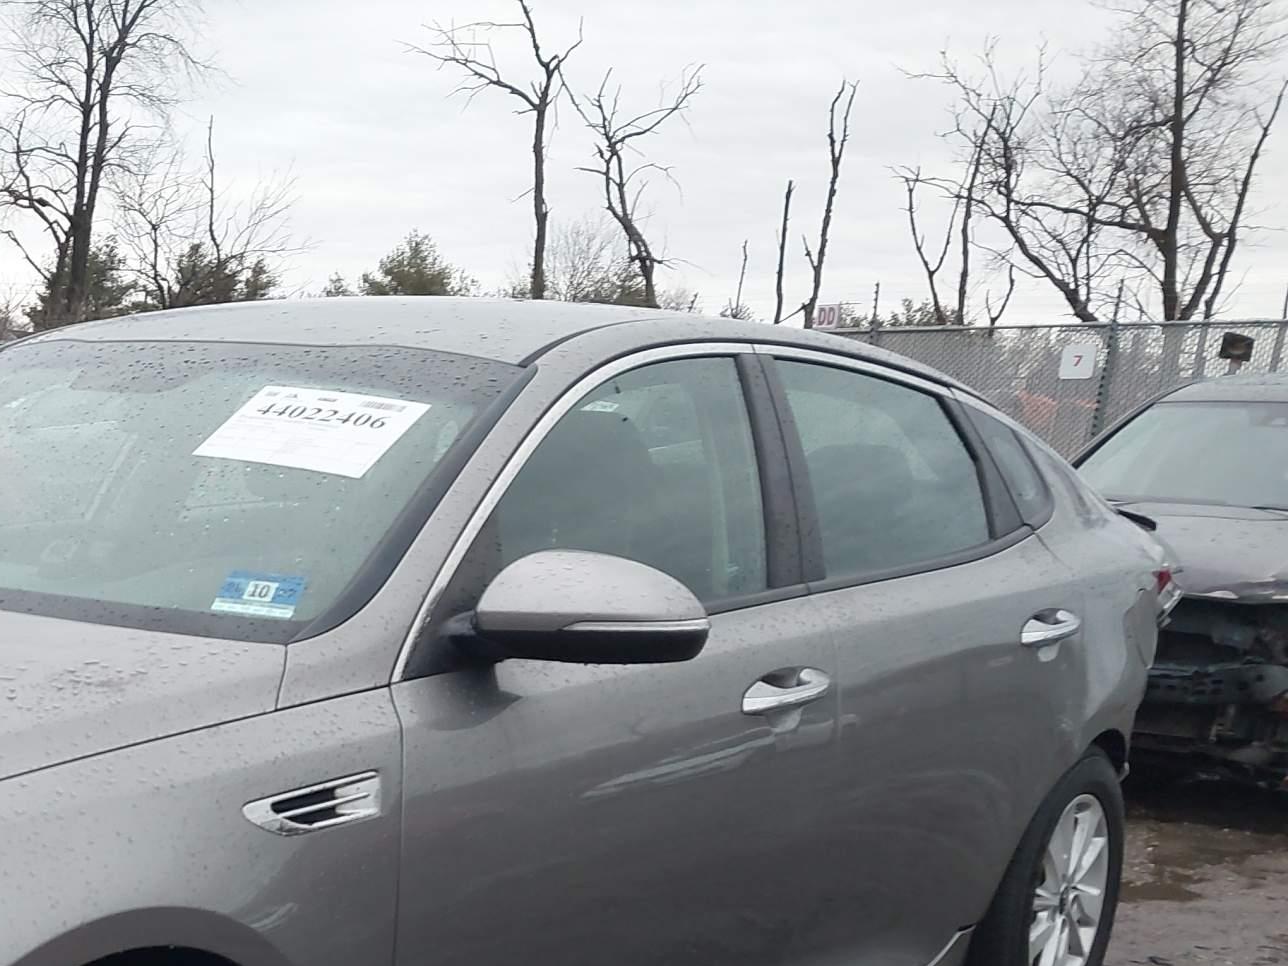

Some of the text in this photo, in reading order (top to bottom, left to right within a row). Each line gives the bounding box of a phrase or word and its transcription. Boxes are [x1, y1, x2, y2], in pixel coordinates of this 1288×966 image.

[1073, 354, 1083, 367] 7
[257, 402, 392, 430] 44022406
[247, 583, 271, 599] 10
